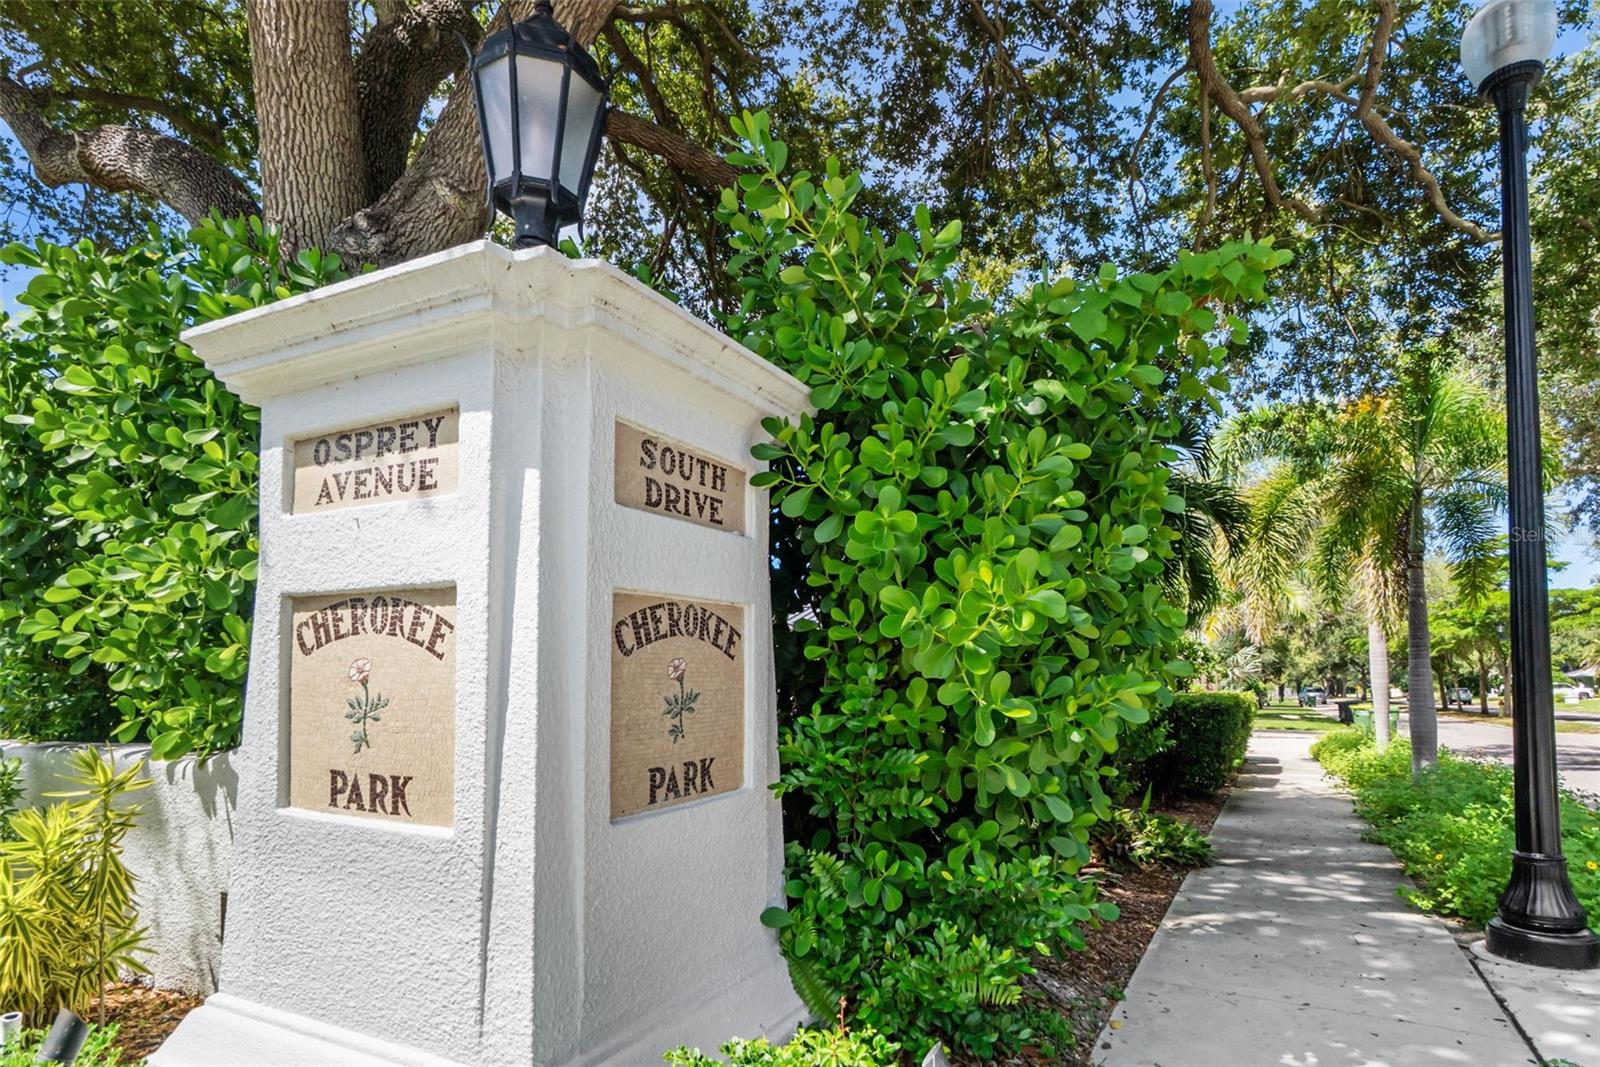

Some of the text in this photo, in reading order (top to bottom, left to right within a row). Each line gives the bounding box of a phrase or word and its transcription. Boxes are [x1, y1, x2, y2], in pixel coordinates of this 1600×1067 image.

[313, 416, 445, 467] OSPREY
[640, 438, 727, 493] SOUTH
[314, 457, 440, 507] AVENUE
[644, 476, 724, 525] DRIVE
[296, 595, 455, 661] CHEROKEE
[614, 602, 741, 661] CHEROKEE
[328, 769, 413, 817] PARK
[647, 757, 716, 806] PARK
